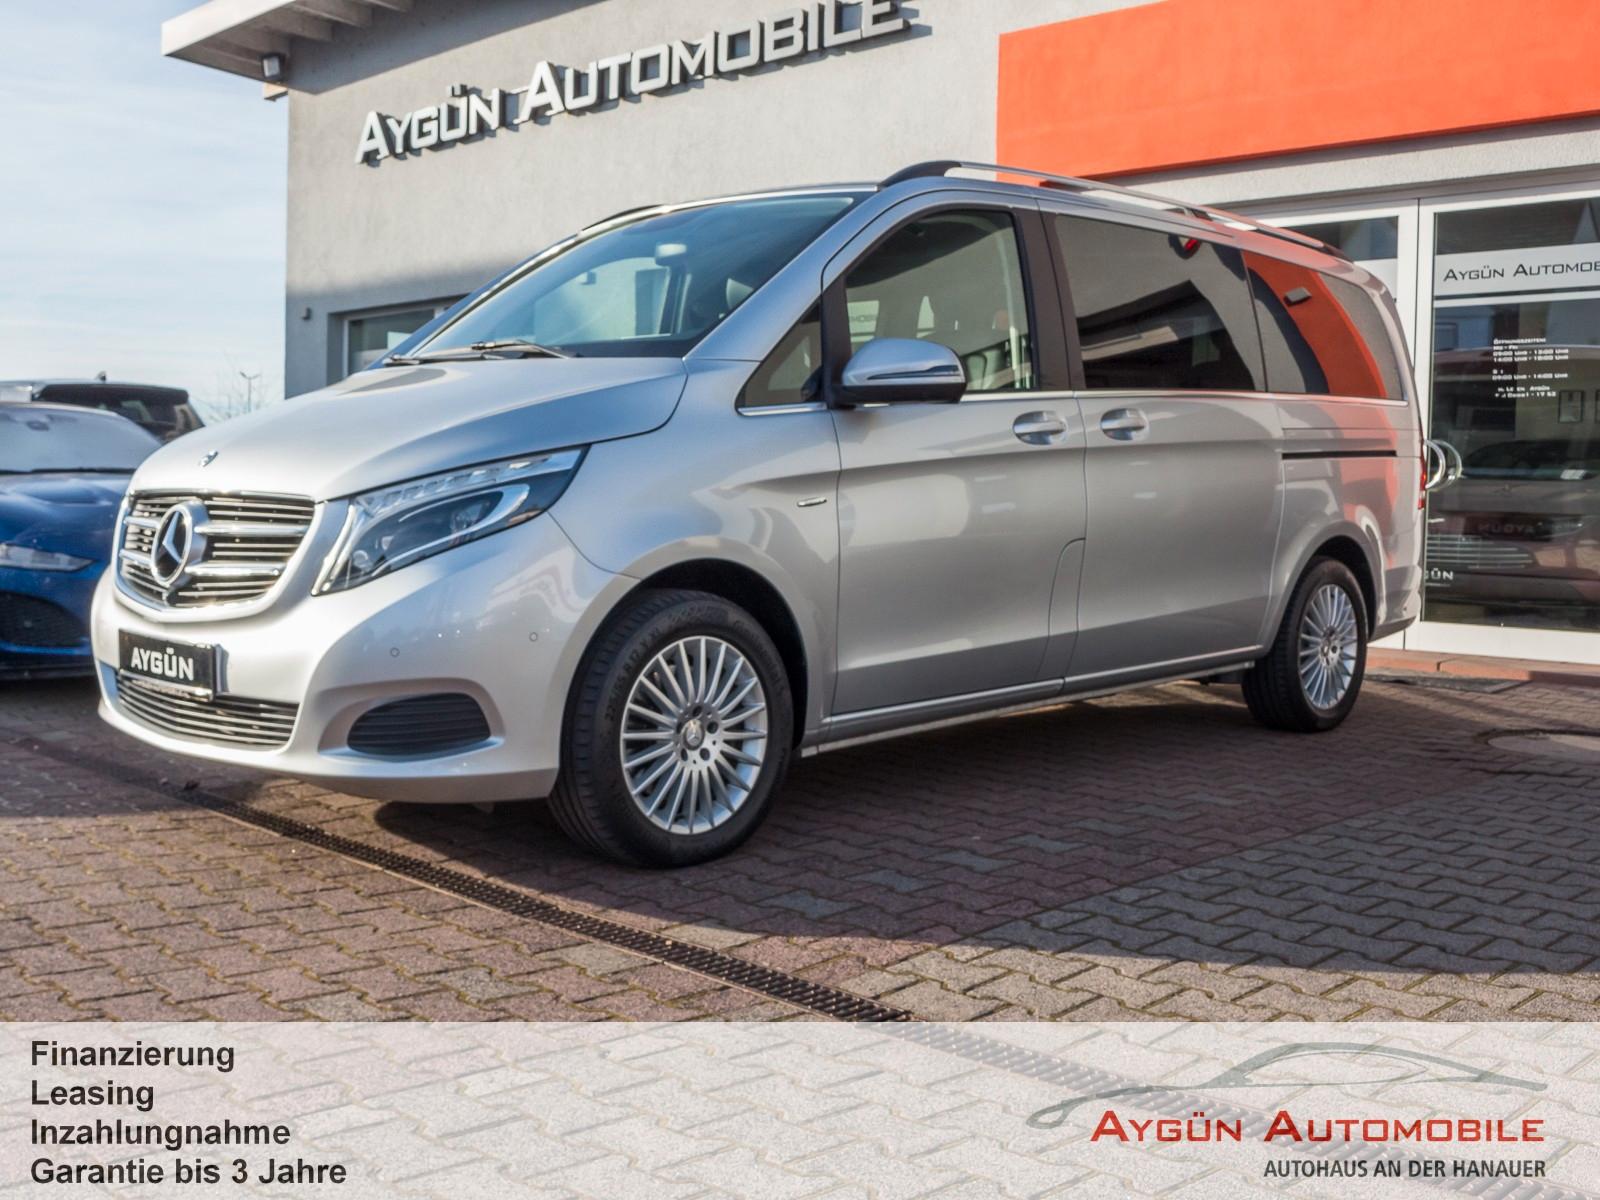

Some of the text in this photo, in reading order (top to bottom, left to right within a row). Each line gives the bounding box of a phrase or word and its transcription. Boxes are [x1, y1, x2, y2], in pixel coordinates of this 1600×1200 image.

[355, 0, 907, 165] AYGÜN AUTOMOBILE
[1443, 265, 1505, 282] AYGÜN
[130, 646, 195, 681] AYGÜN
